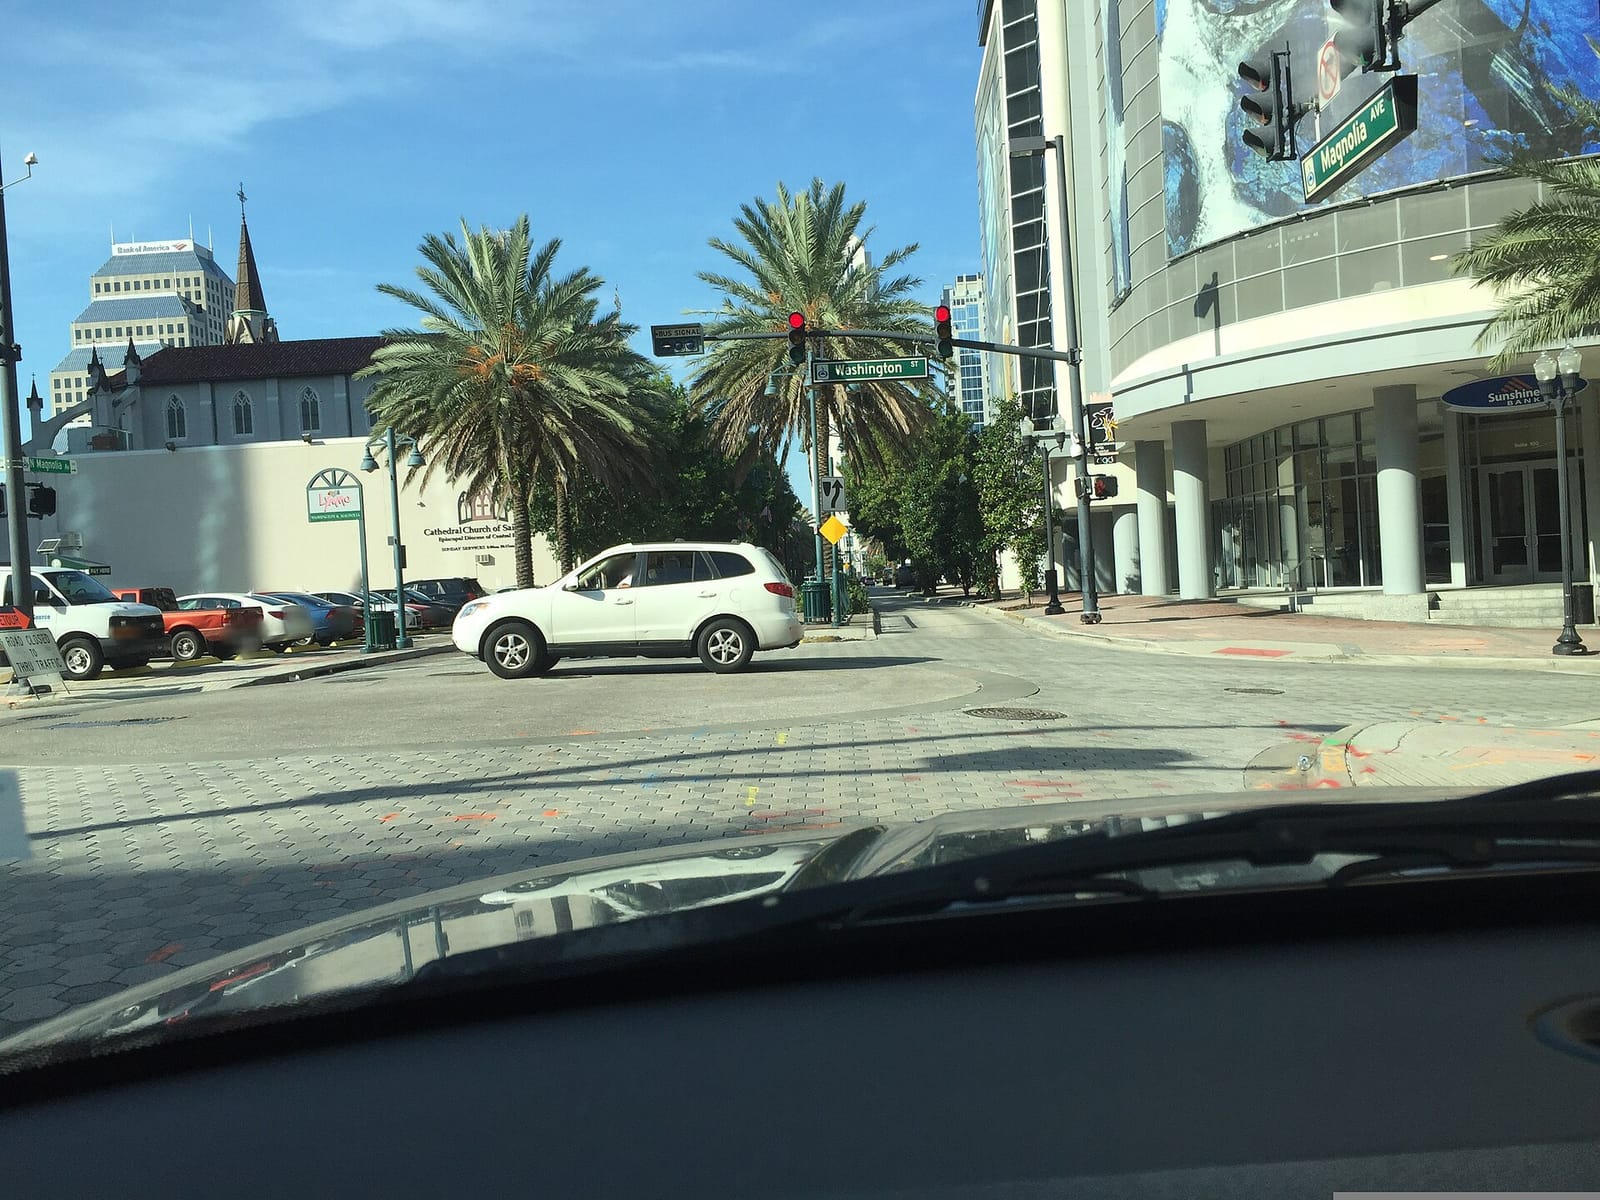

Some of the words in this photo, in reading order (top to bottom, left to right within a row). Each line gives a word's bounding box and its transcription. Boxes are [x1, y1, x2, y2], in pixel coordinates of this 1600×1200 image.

[1320, 120, 1368, 173] Magnolia
[1370, 98, 1385, 122] AVE
[117, 246, 135, 254] Bank
[135, 245, 141, 253] of
[143, 244, 170, 252] America
[674, 328, 701, 336] SIGNAL
[835, 362, 902, 377] Washington
[1488, 388, 1540, 403] Sunshine
[1507, 397, 1541, 406] BANK
[36, 458, 63, 472] Magnolia
[424, 526, 462, 536] Cathedral
[463, 525, 491, 534] Church
[492, 524, 501, 532] of
[502, 524, 516, 532] Sai
[439, 535, 464, 543] Episcopal
[0, 614, 19, 626] ETOUR
[5, 635, 24, 648] ROAD
[25, 633, 51, 646] CLOSED
[29, 648, 38, 658] TO
[16, 660, 35, 673] THRU
[35, 657, 62, 671] TRAFFIC
